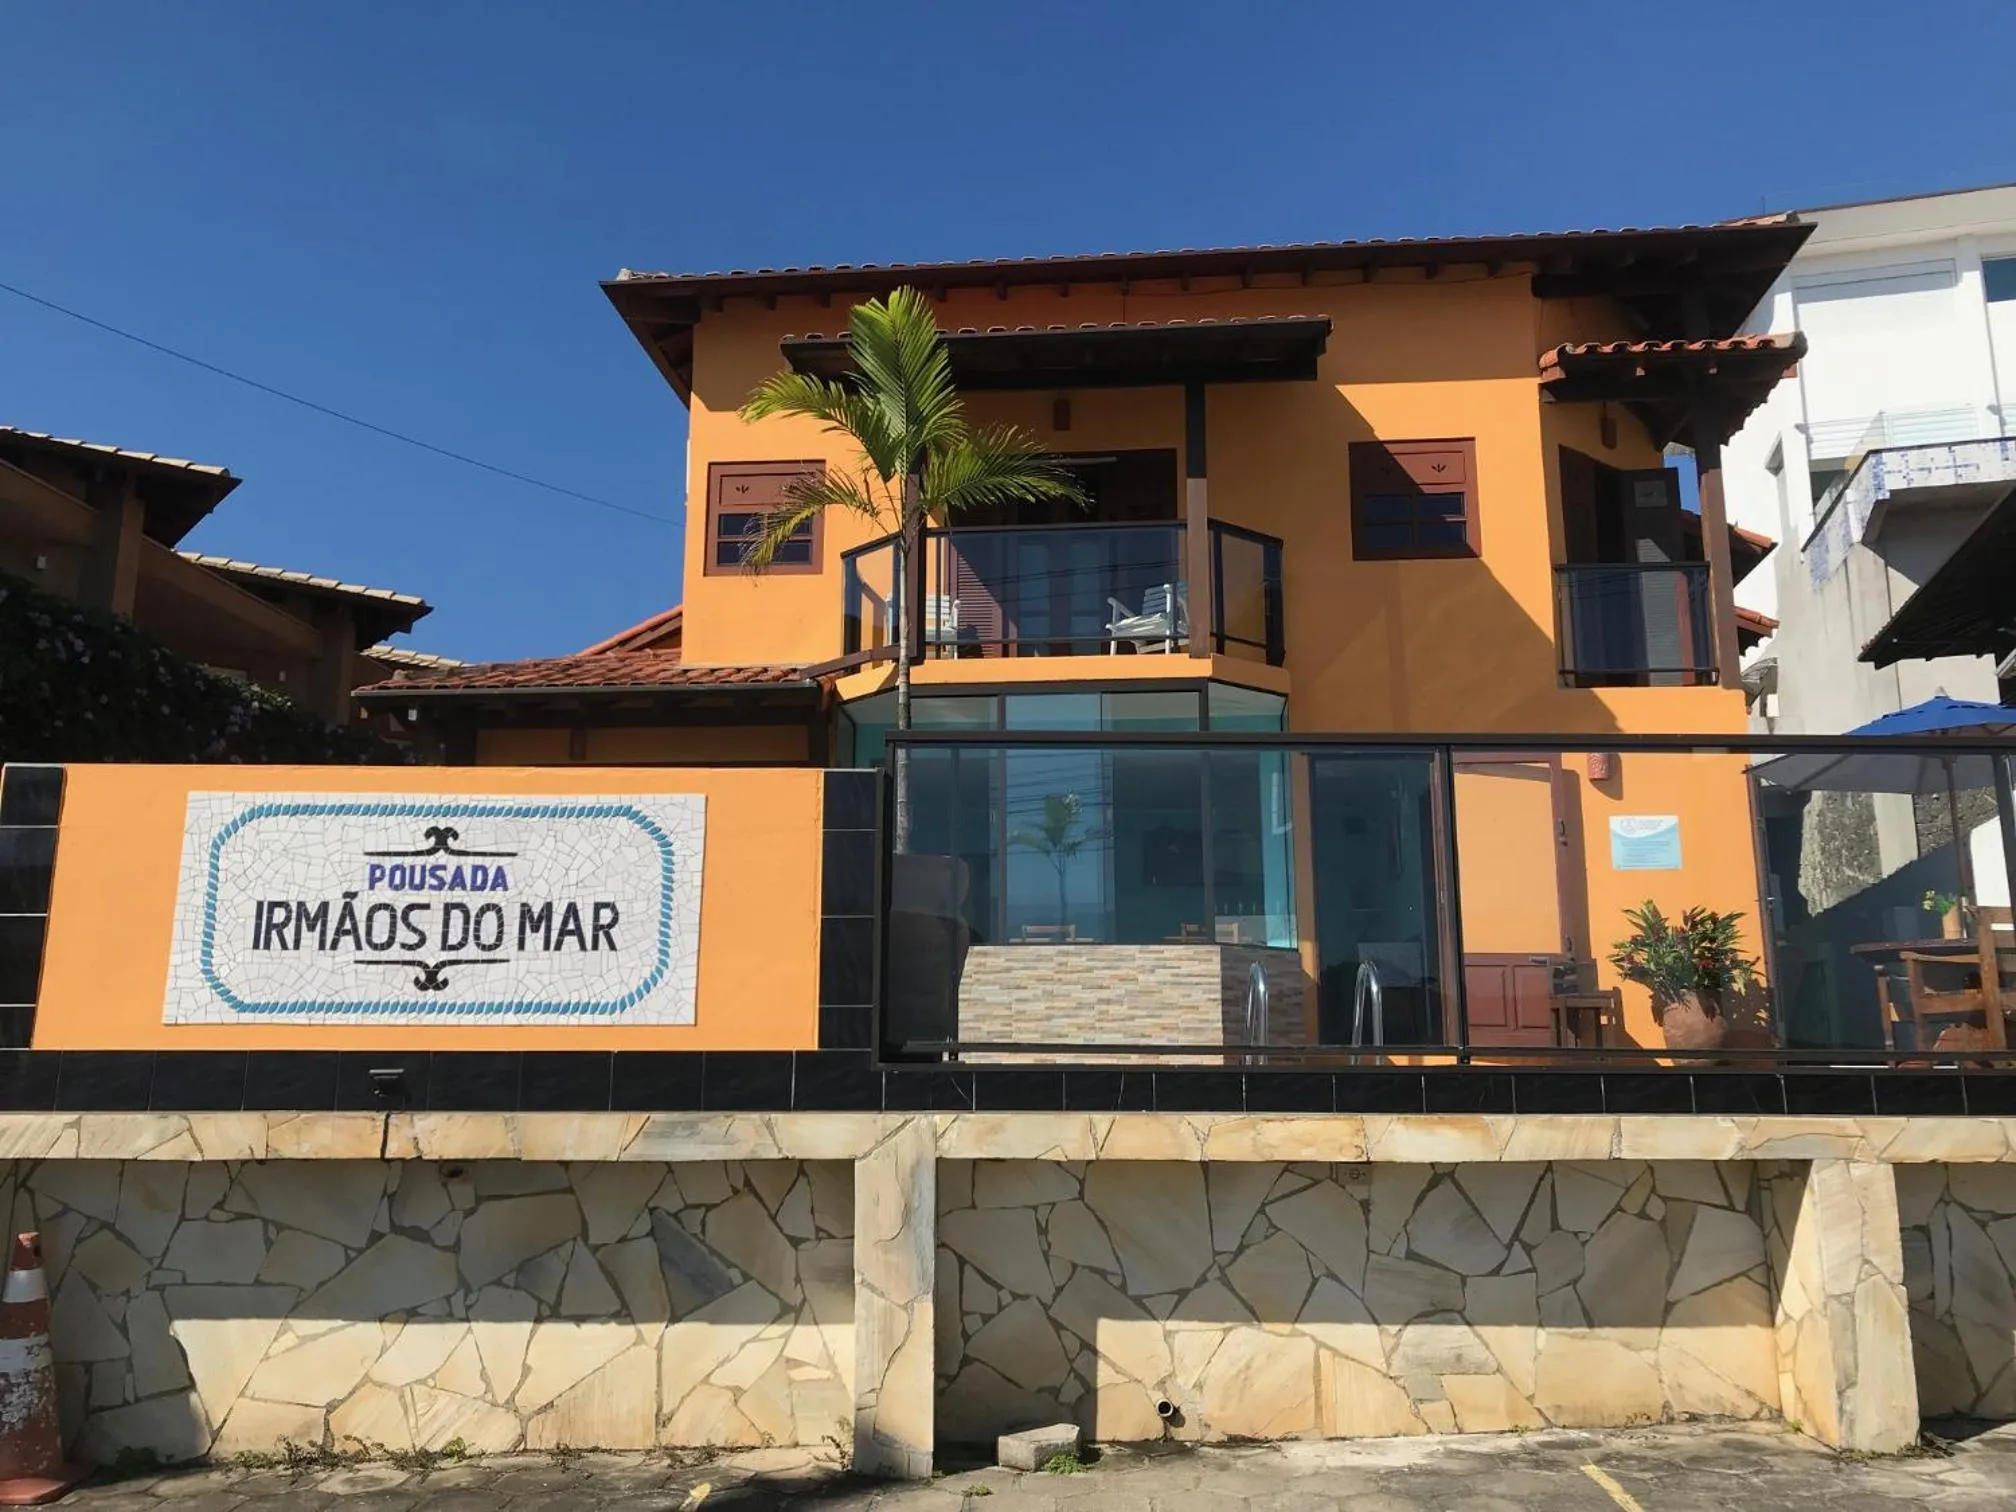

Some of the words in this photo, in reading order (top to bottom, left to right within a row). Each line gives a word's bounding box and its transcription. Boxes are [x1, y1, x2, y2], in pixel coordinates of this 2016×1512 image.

[368, 864, 508, 891] POUSADA
[253, 891, 429, 951] IRMÃOS
[441, 901, 505, 951] DO
[517, 901, 620, 951] MAR
